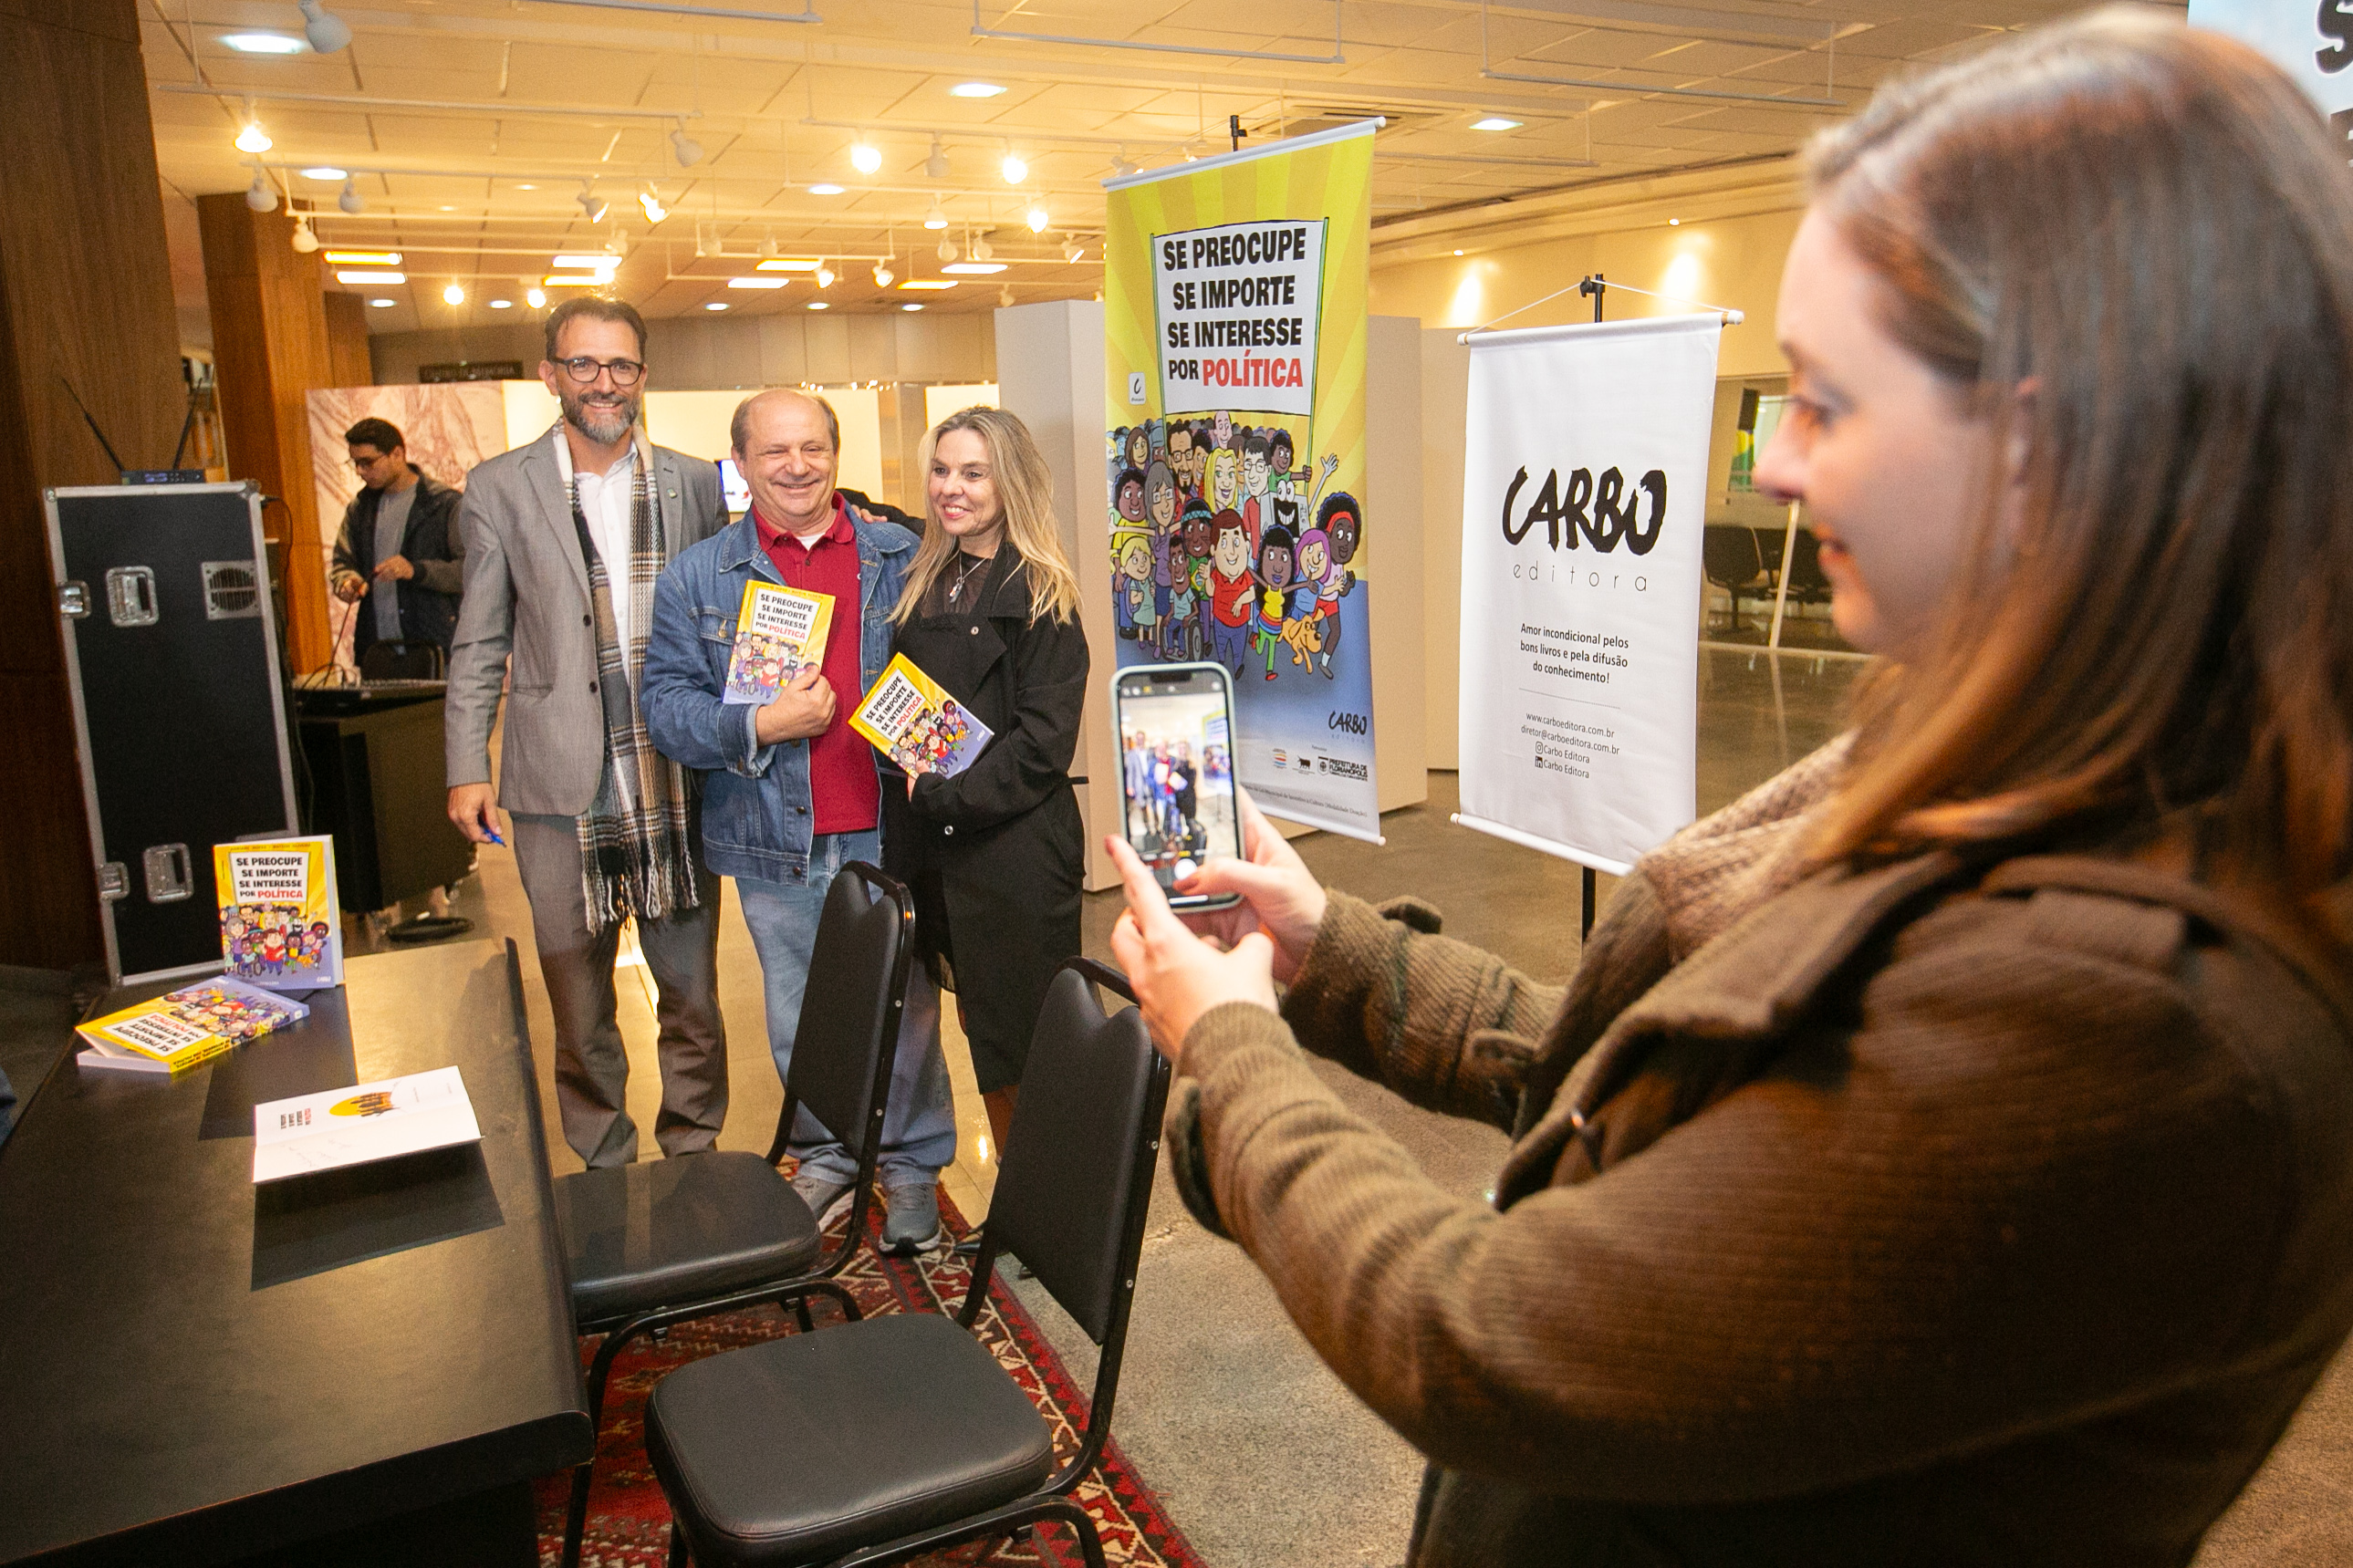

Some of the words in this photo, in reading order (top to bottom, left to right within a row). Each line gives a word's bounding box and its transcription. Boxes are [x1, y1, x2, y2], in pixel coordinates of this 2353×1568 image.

[1163, 240, 1187, 271] SE
[1192, 228, 1307, 269] PREOCUPE
[1173, 282, 1196, 310] SE
[1202, 275, 1296, 308] IMPORTE
[1168, 322, 1190, 348] SE
[1194, 317, 1303, 348] INTERESSE
[1169, 359, 1199, 380] POR
[1203, 348, 1303, 388] POLÍTICA
[1502, 465, 1667, 556] CARBO
[1513, 560, 1647, 592] editora
[760, 593, 770, 602] SE
[772, 597, 813, 612] PREOCUPE
[762, 604, 771, 612] SE
[773, 607, 807, 620] IMPORTE
[768, 615, 807, 629] INTERESSE
[768, 624, 806, 639] POLÍTICA
[1520, 623, 1541, 636] Amor
[1543, 626, 1600, 644] incondicional
[1603, 636, 1629, 649] pelos
[1520, 640, 1538, 653] bons
[1540, 643, 1561, 658] livros
[1563, 650, 1567, 659] e
[1570, 650, 1589, 661] pela
[1592, 652, 1628, 668] difusão
[1533, 660, 1542, 672] do
[1544, 664, 1609, 683] conhecimento!
[866, 710, 876, 721] SE
[874, 676, 902, 711] PREOCUPE
[876, 713, 885, 724] SE
[883, 685, 907, 716] IMPORTE
[881, 722, 890, 732] SE
[889, 690, 916, 724] INTERESSE
[888, 726, 899, 737] POR
[897, 696, 921, 727] POLÍTICA
[1328, 710, 1368, 735] CARBO
[1526, 712, 1615, 738] www.carboeditora.com.br
[1521, 724, 1619, 755] diretor@carboeditora.com.br
[1544, 745, 1563, 757] Carbo
[1565, 750, 1590, 763] Editora
[1544, 760, 1563, 772] Carbo
[1565, 764, 1589, 778] Editora
[236, 857, 248, 866] SE
[251, 857, 302, 866] PREOCUPE
[256, 868, 298, 877] IMPORTE
[254, 879, 302, 888] INTERESSE
[257, 887, 303, 898] POLÍTICA
[113, 1026, 161, 1047] PREOCUPE
[129, 1023, 168, 1043] IMPORTE
[138, 1019, 182, 1038] INTERESSE
[158, 1044, 172, 1053] SE
